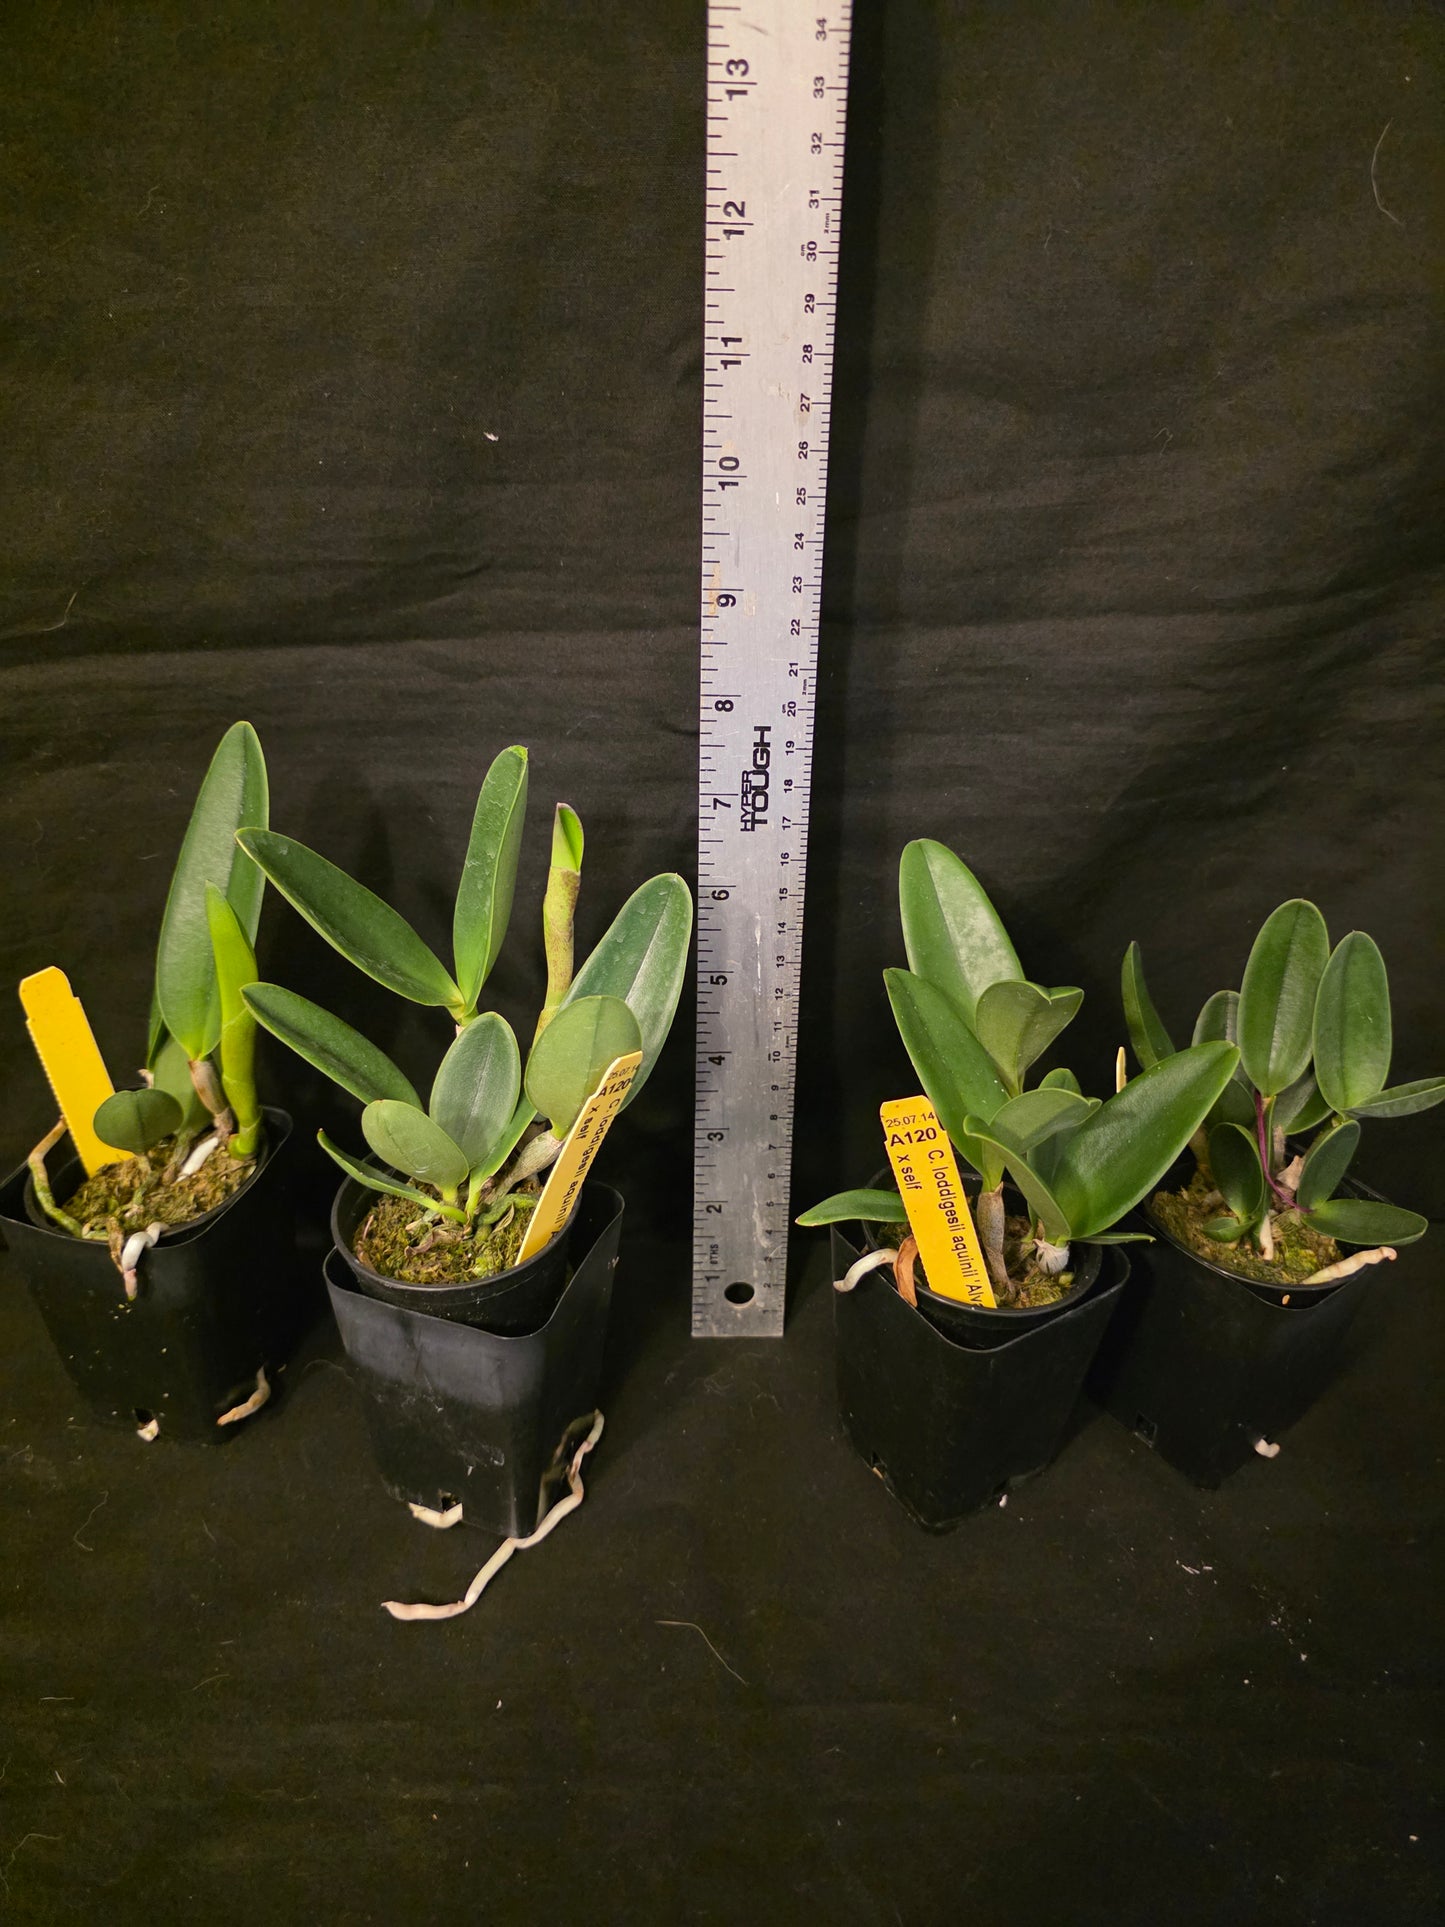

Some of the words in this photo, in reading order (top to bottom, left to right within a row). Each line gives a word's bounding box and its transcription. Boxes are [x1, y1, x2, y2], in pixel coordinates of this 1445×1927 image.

[815, 18, 827, 41] 34
[725, 58, 749, 101] 13
[813, 76, 825, 99] 33
[811, 132, 822, 155] 32
[809, 189, 820, 209] 31
[723, 201, 745, 240] 12
[806, 240, 817, 262] 30
[804, 293, 815, 314] 29
[720, 337, 742, 370] 11
[802, 344, 813, 363] 28
[800, 393, 810, 412] 27
[798, 441, 808, 460] 26
[718, 456, 740, 491] 10
[796, 487, 806, 505] 25
[794, 532, 804, 550] 24
[792, 576, 803, 594] 23
[716, 593, 736, 608] 9
[790, 618, 800, 636] 22
[788, 662, 799, 677] 21
[714, 699, 734, 713] 8
[787, 701, 796, 717] 20
[785, 740, 795, 756] 19
[750, 725, 771, 832] TOUGH
[783, 778, 793, 793] 18
[713, 797, 731, 810] 7
[740, 770, 752, 832] HYPER
[781, 816, 791, 830] 17
[780, 852, 790, 867] 16
[711, 889, 730, 901] 6
[779, 887, 788, 901] 15
[777, 921, 786, 935] 14
[776, 955, 785, 968] 13
[710, 975, 728, 986] 5
[775, 988, 784, 1000] 12
[773, 1021, 782, 1032] 11
[708, 1055, 725, 1066] 4
[772, 1050, 781, 1063] 10
[596, 1078, 631, 1099] A120
[771, 1084, 779, 1092] 9
[886, 1111, 935, 1128] 25.07.14
[707, 1131, 724, 1142] 3
[890, 1127, 937, 1147] A120
[901, 1166, 922, 1190] self
[706, 1204, 722, 1214] 2
[932, 1166, 965, 1232] loddigesii
[952, 1235, 979, 1278] aquinii
[704, 1275, 720, 1283] 1
